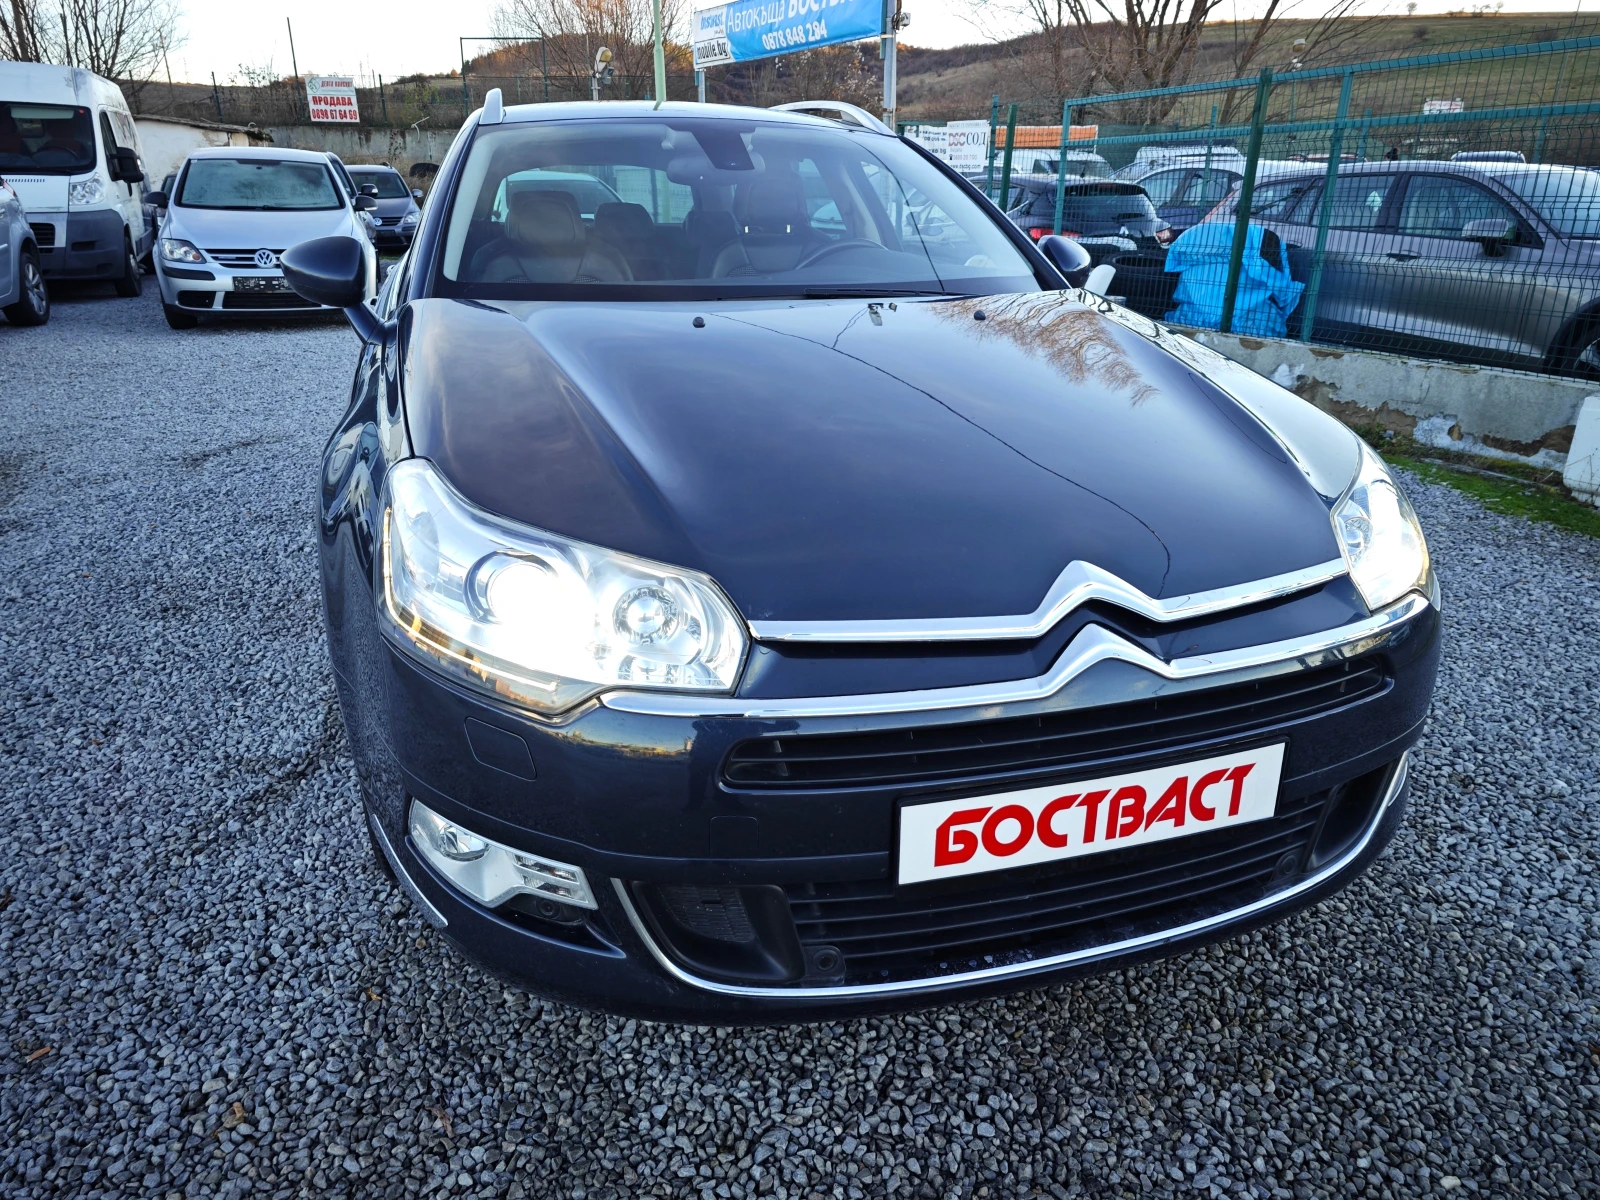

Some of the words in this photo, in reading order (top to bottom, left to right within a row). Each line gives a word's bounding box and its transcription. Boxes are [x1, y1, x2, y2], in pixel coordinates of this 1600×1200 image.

[762, 29, 786, 50] 0878
[786, 24, 806, 45] 848
[806, 18, 827, 41] 284
[312, 96, 353, 107] ПРОДАВА
[966, 132, 986, 147] СОД
[934, 763, 1256, 867] БОСТВАСТ
